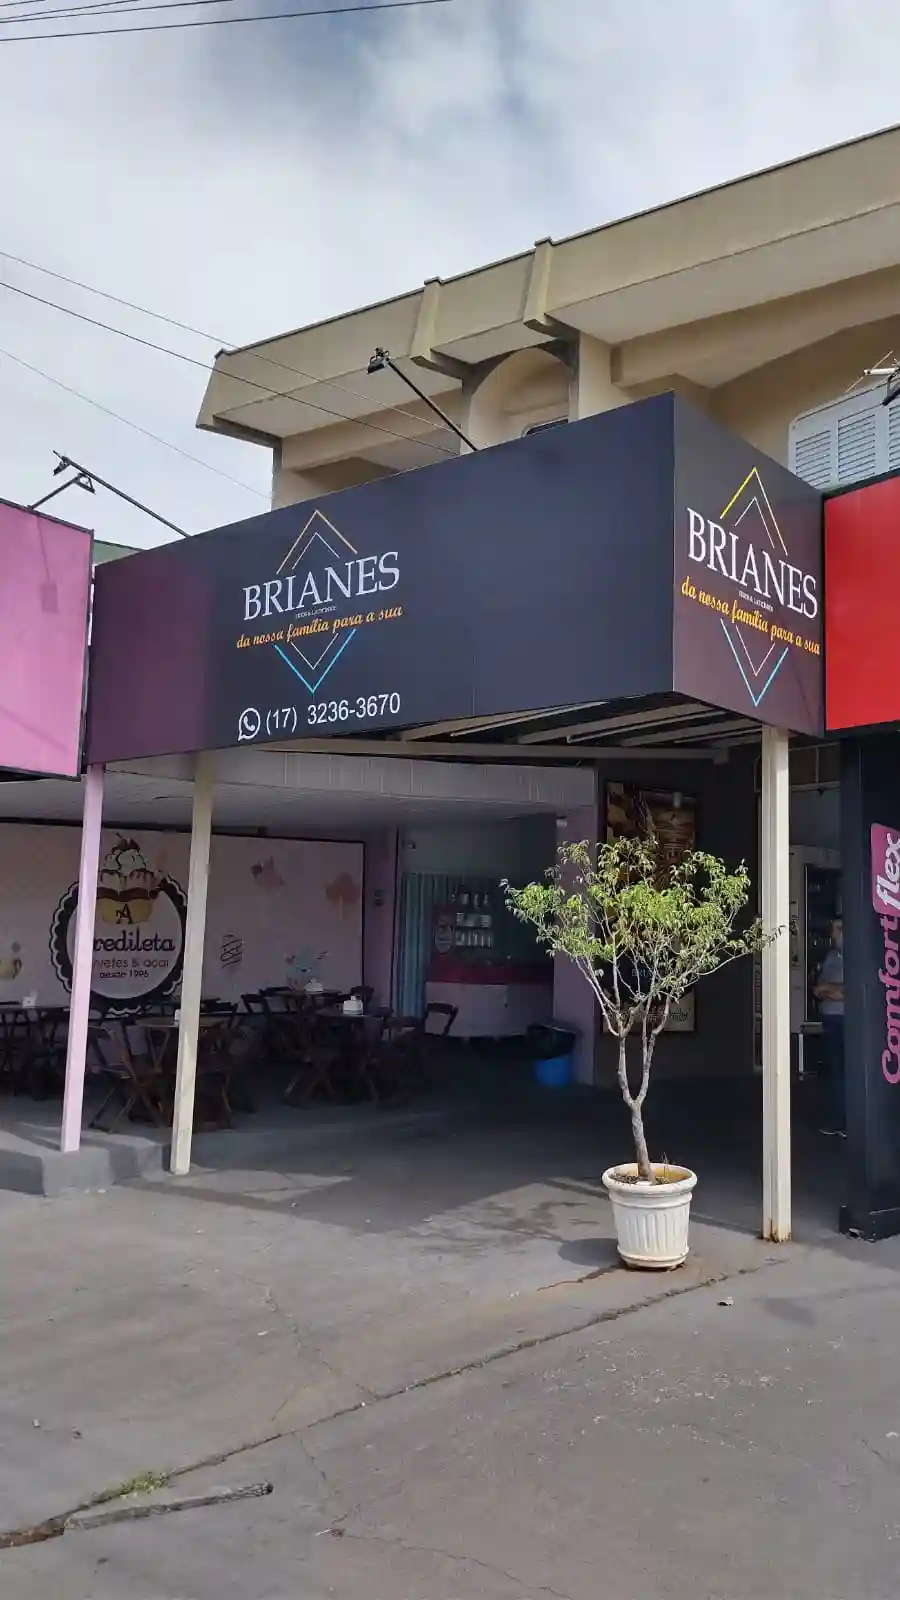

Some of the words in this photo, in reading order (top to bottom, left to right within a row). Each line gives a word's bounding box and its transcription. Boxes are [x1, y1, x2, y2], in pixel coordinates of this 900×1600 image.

[242, 551, 400, 620] BRIANES
[687, 507, 818, 619] BRIANES
[236, 633, 250, 649] da
[253, 631, 284, 645] nossa
[333, 613, 362, 634] para
[366, 612, 376, 622] a
[378, 606, 402, 619] sua
[681, 576, 697, 598] da
[699, 590, 729, 614] nossa
[771, 625, 793, 643] para
[795, 634, 802, 647] a
[804, 640, 820, 655] sua
[266, 706, 298, 736] (17)
[307, 692, 401, 725] 3236-3670
[93, 927, 176, 951] redileta
